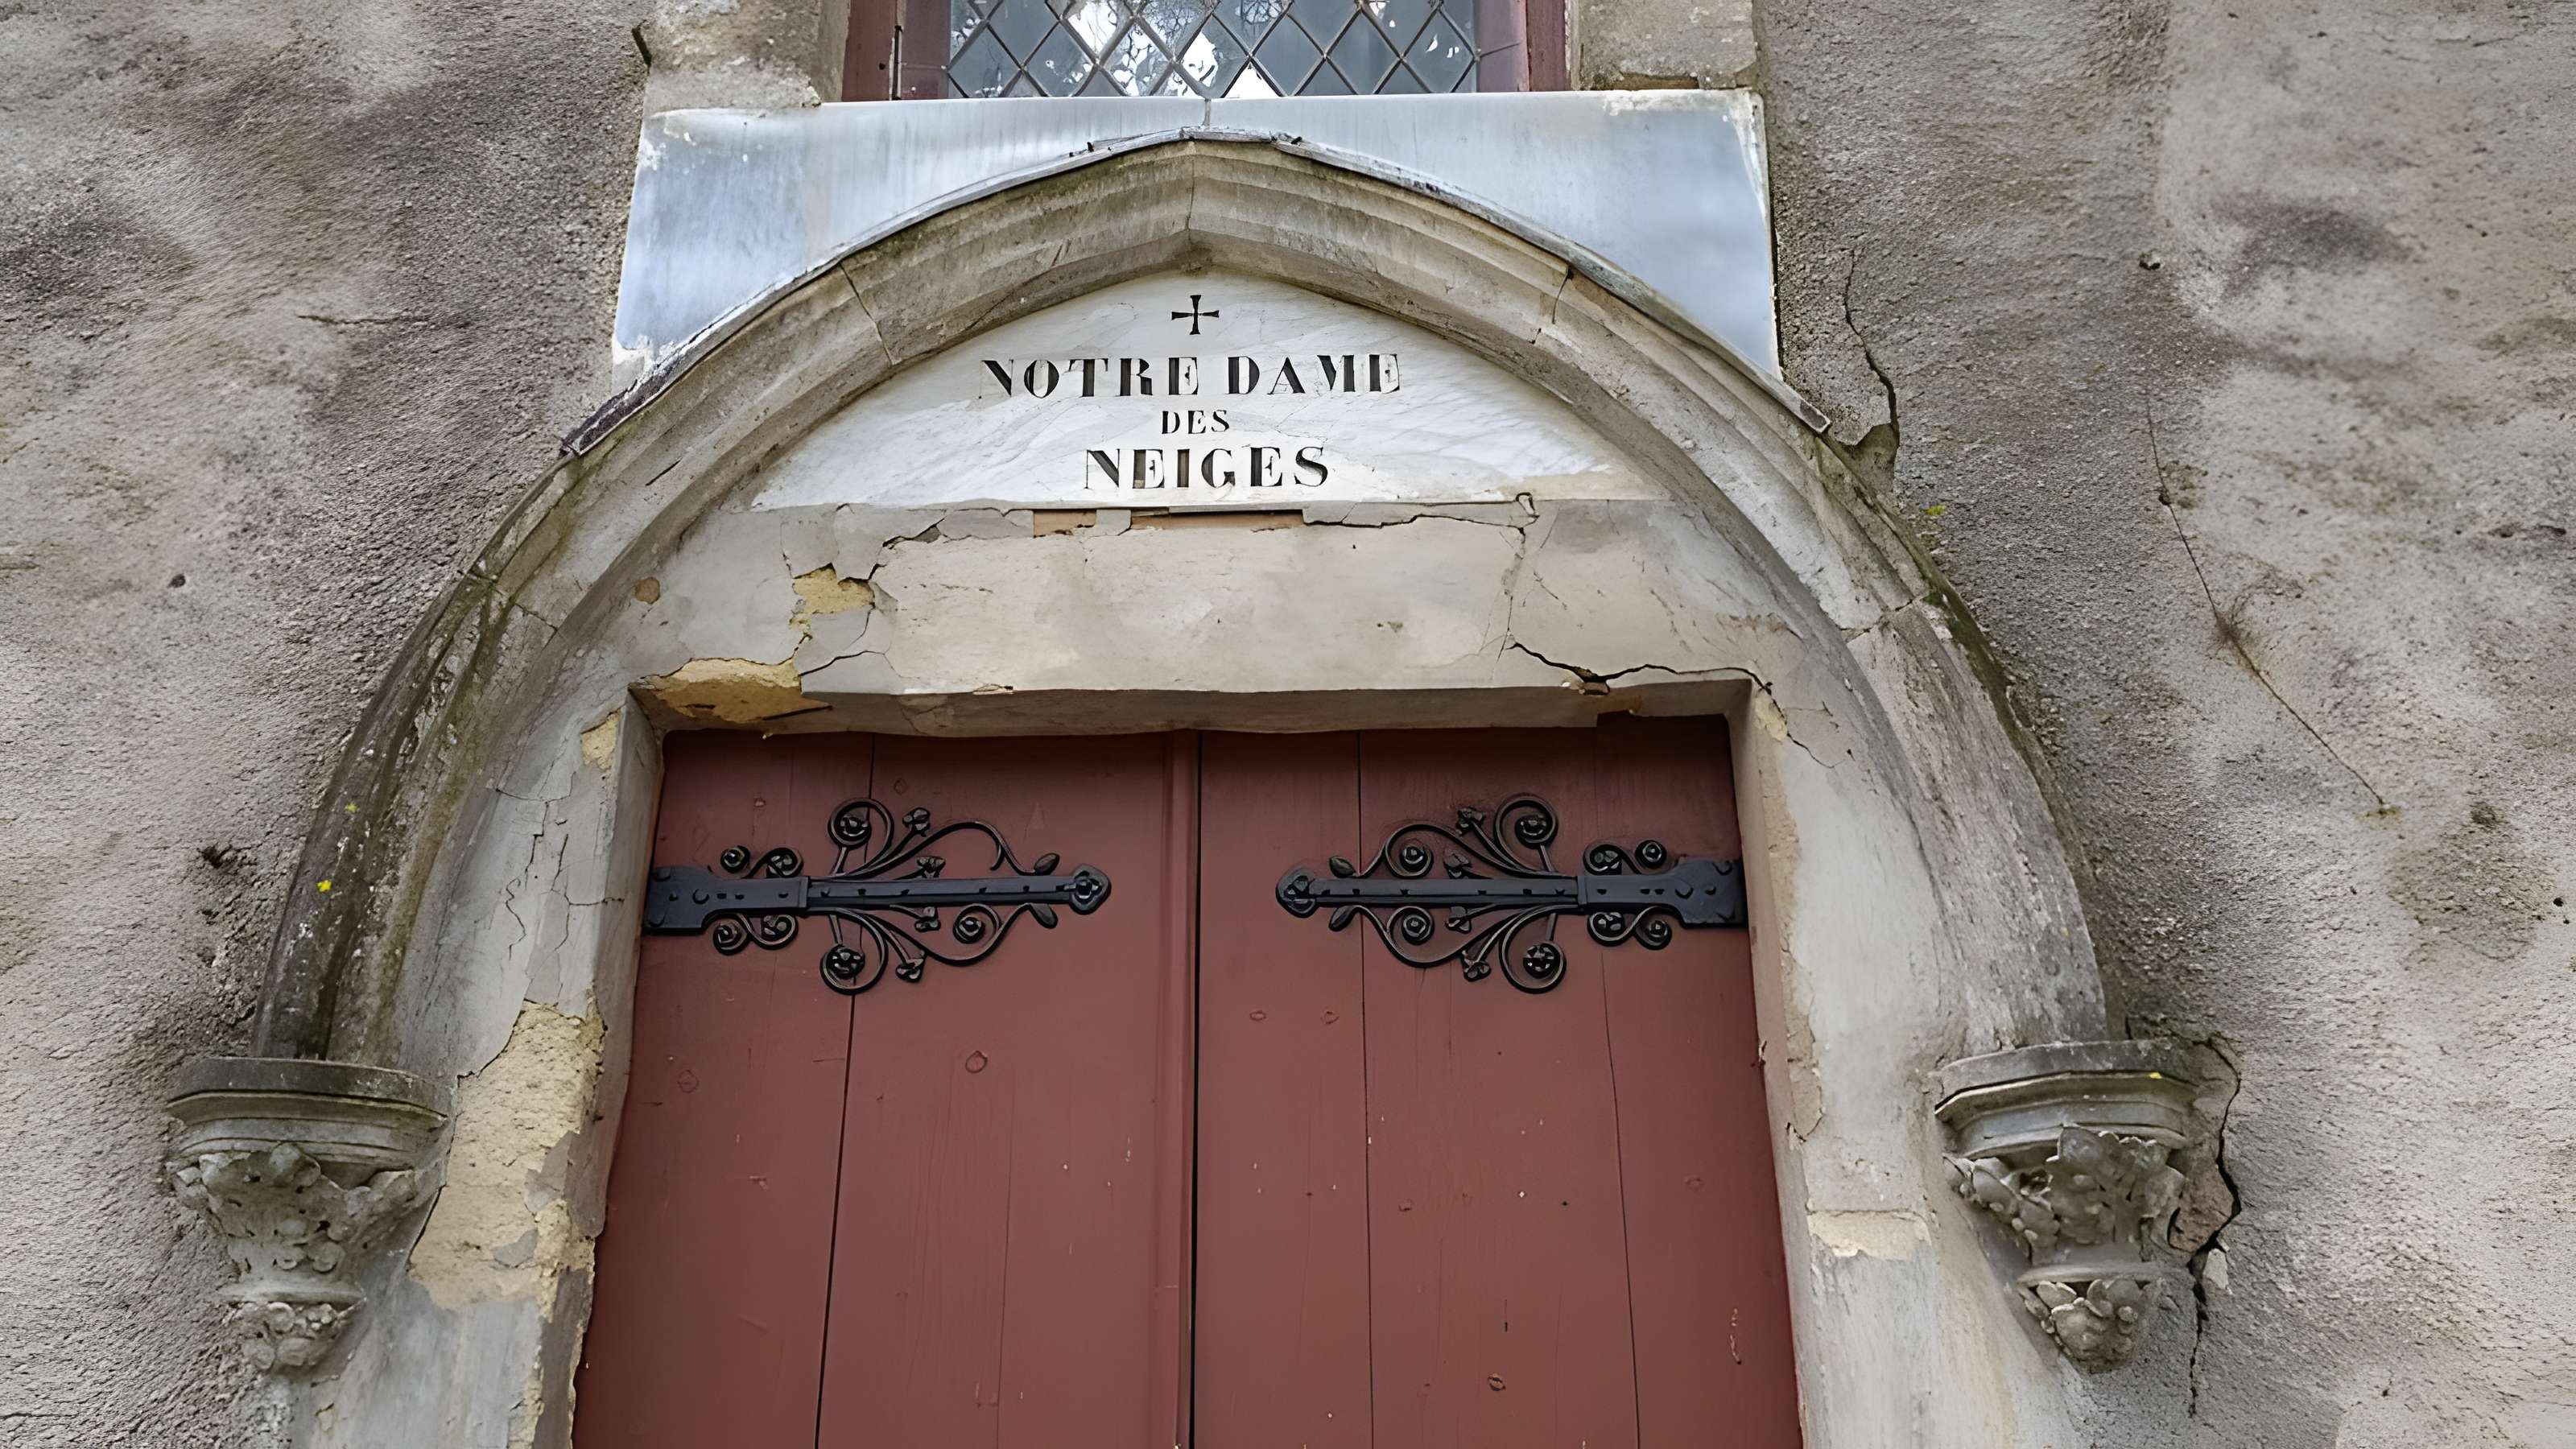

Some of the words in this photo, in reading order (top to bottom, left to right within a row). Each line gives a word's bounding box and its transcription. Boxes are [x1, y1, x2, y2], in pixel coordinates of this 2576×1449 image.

[980, 357, 1199, 398] NOTRE
[1228, 353, 1402, 395] DAME
[1161, 410, 1230, 435] DES
[1085, 447, 1328, 489] NEIGES
